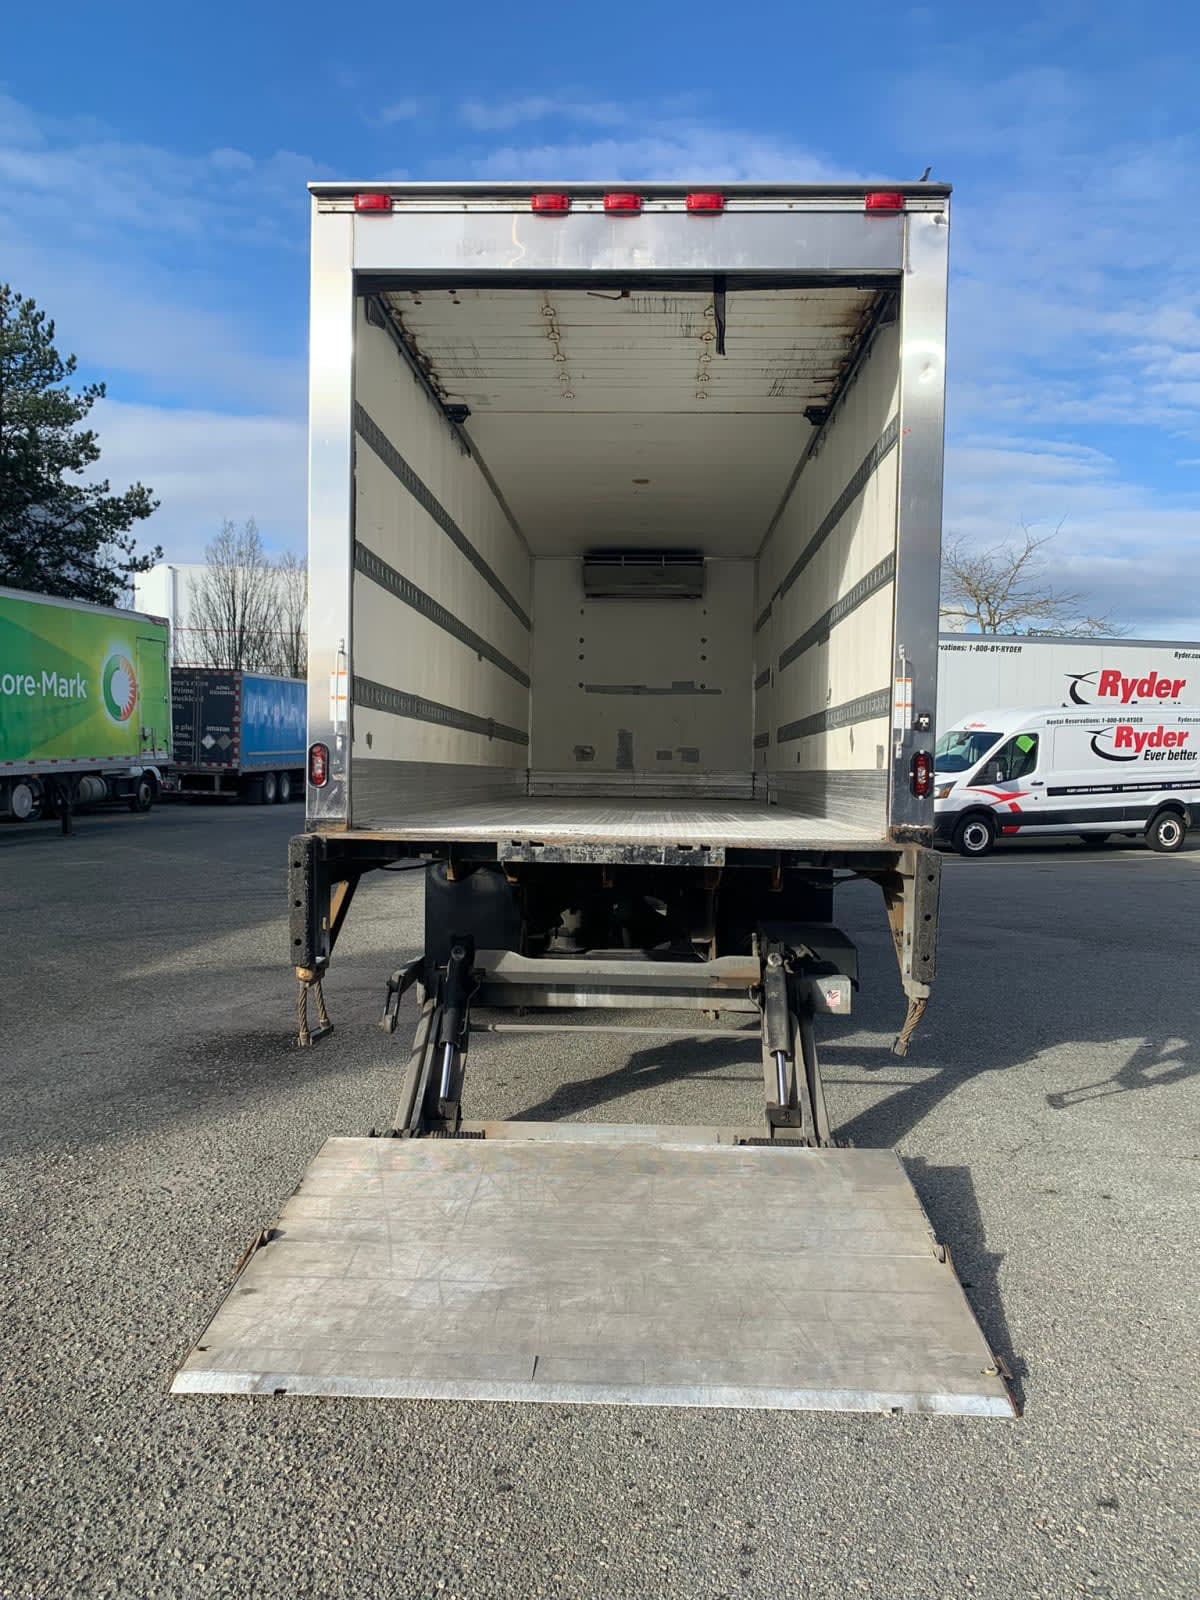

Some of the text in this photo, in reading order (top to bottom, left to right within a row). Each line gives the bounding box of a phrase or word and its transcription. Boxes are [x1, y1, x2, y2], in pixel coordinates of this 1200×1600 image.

[969, 645, 1022, 653] 1-800-BY-RYDER
[1174, 651, 1200, 660] Ryder.co
[1098, 669, 1186, 704] Ryder
[1115, 725, 1189, 753] Ryder
[1144, 749, 1198, 761] Ever better.
